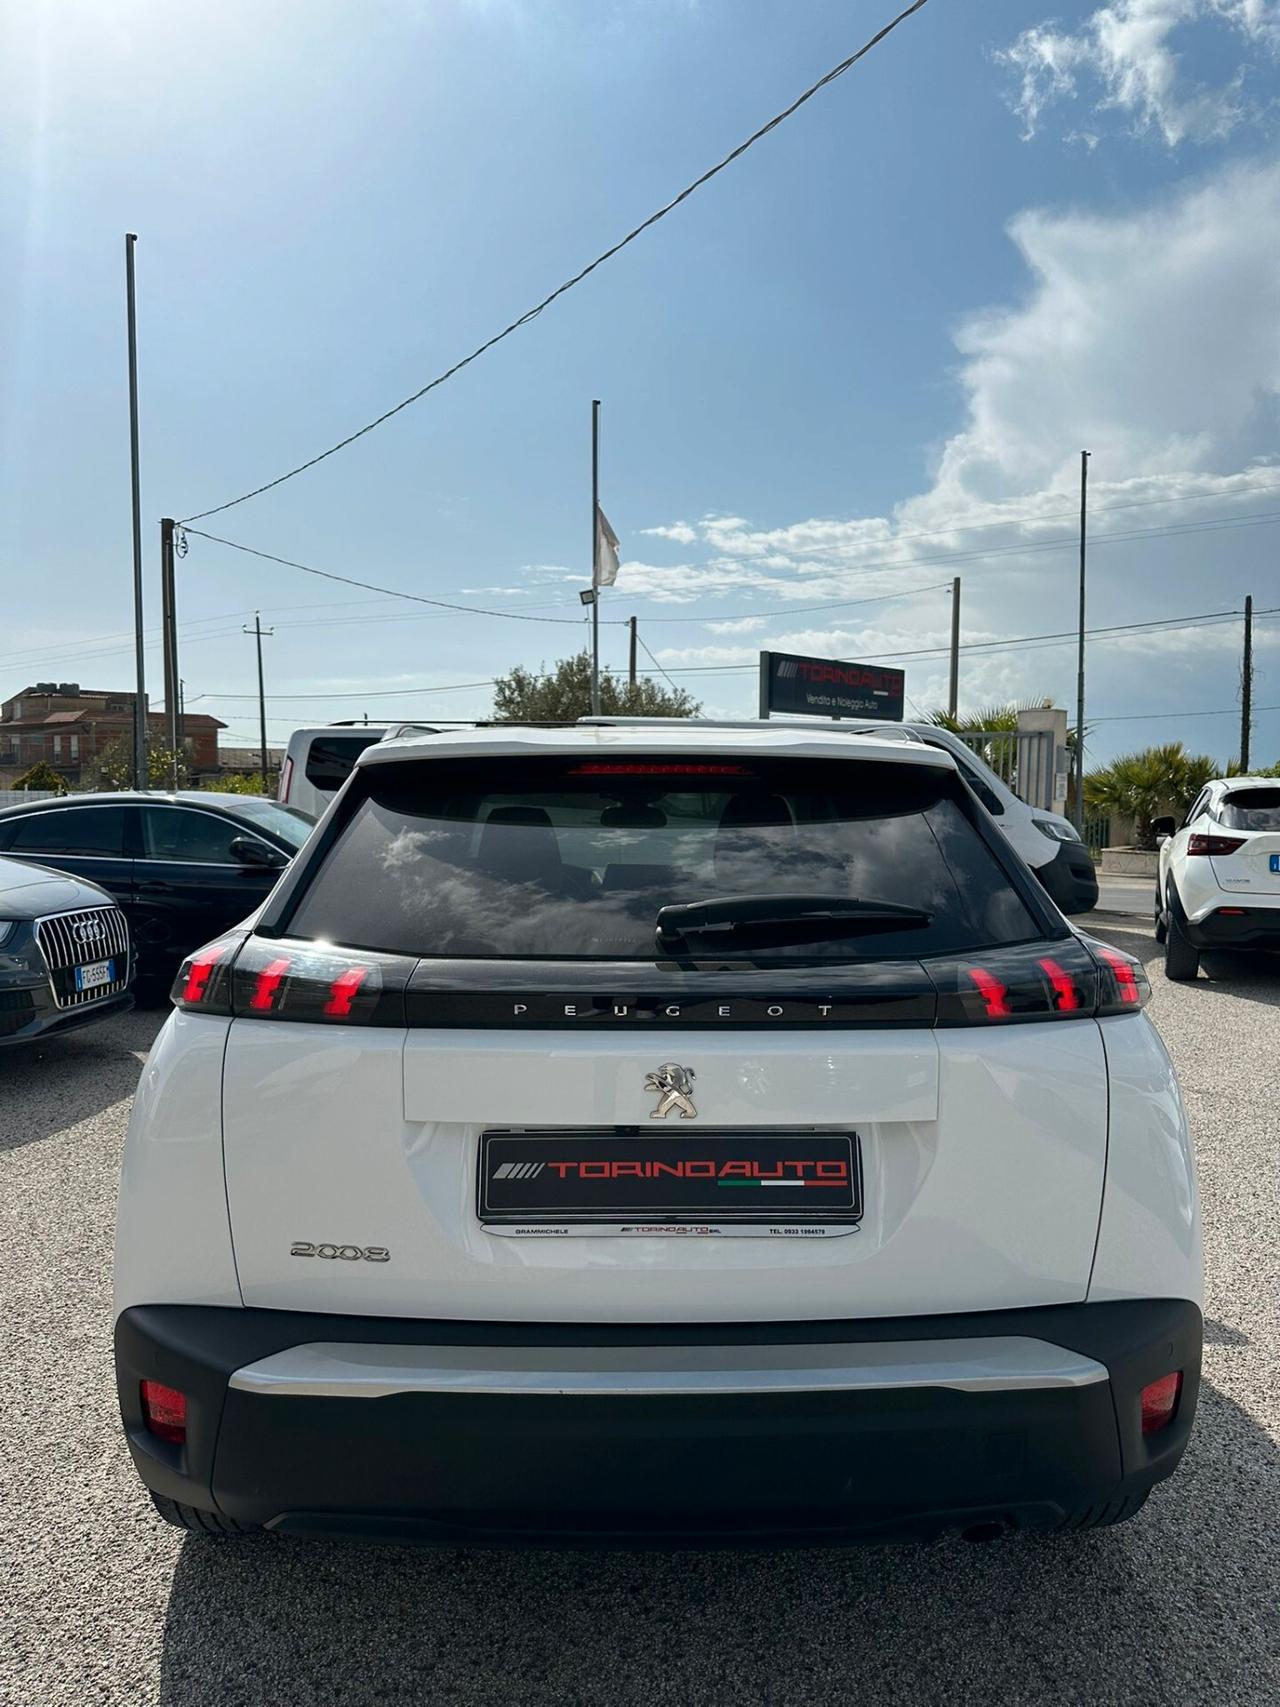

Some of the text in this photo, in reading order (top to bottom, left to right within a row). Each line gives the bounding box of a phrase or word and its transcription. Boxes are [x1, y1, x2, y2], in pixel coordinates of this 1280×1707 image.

[806, 693, 830, 706] Vendita
[837, 695, 864, 710] Noleggio
[865, 701, 878, 710] Auto
[513, 1004, 833, 1017] PEUGEOT
[547, 1161, 848, 1178] TORINOAUTO
[290, 1241, 391, 1262] 2008
